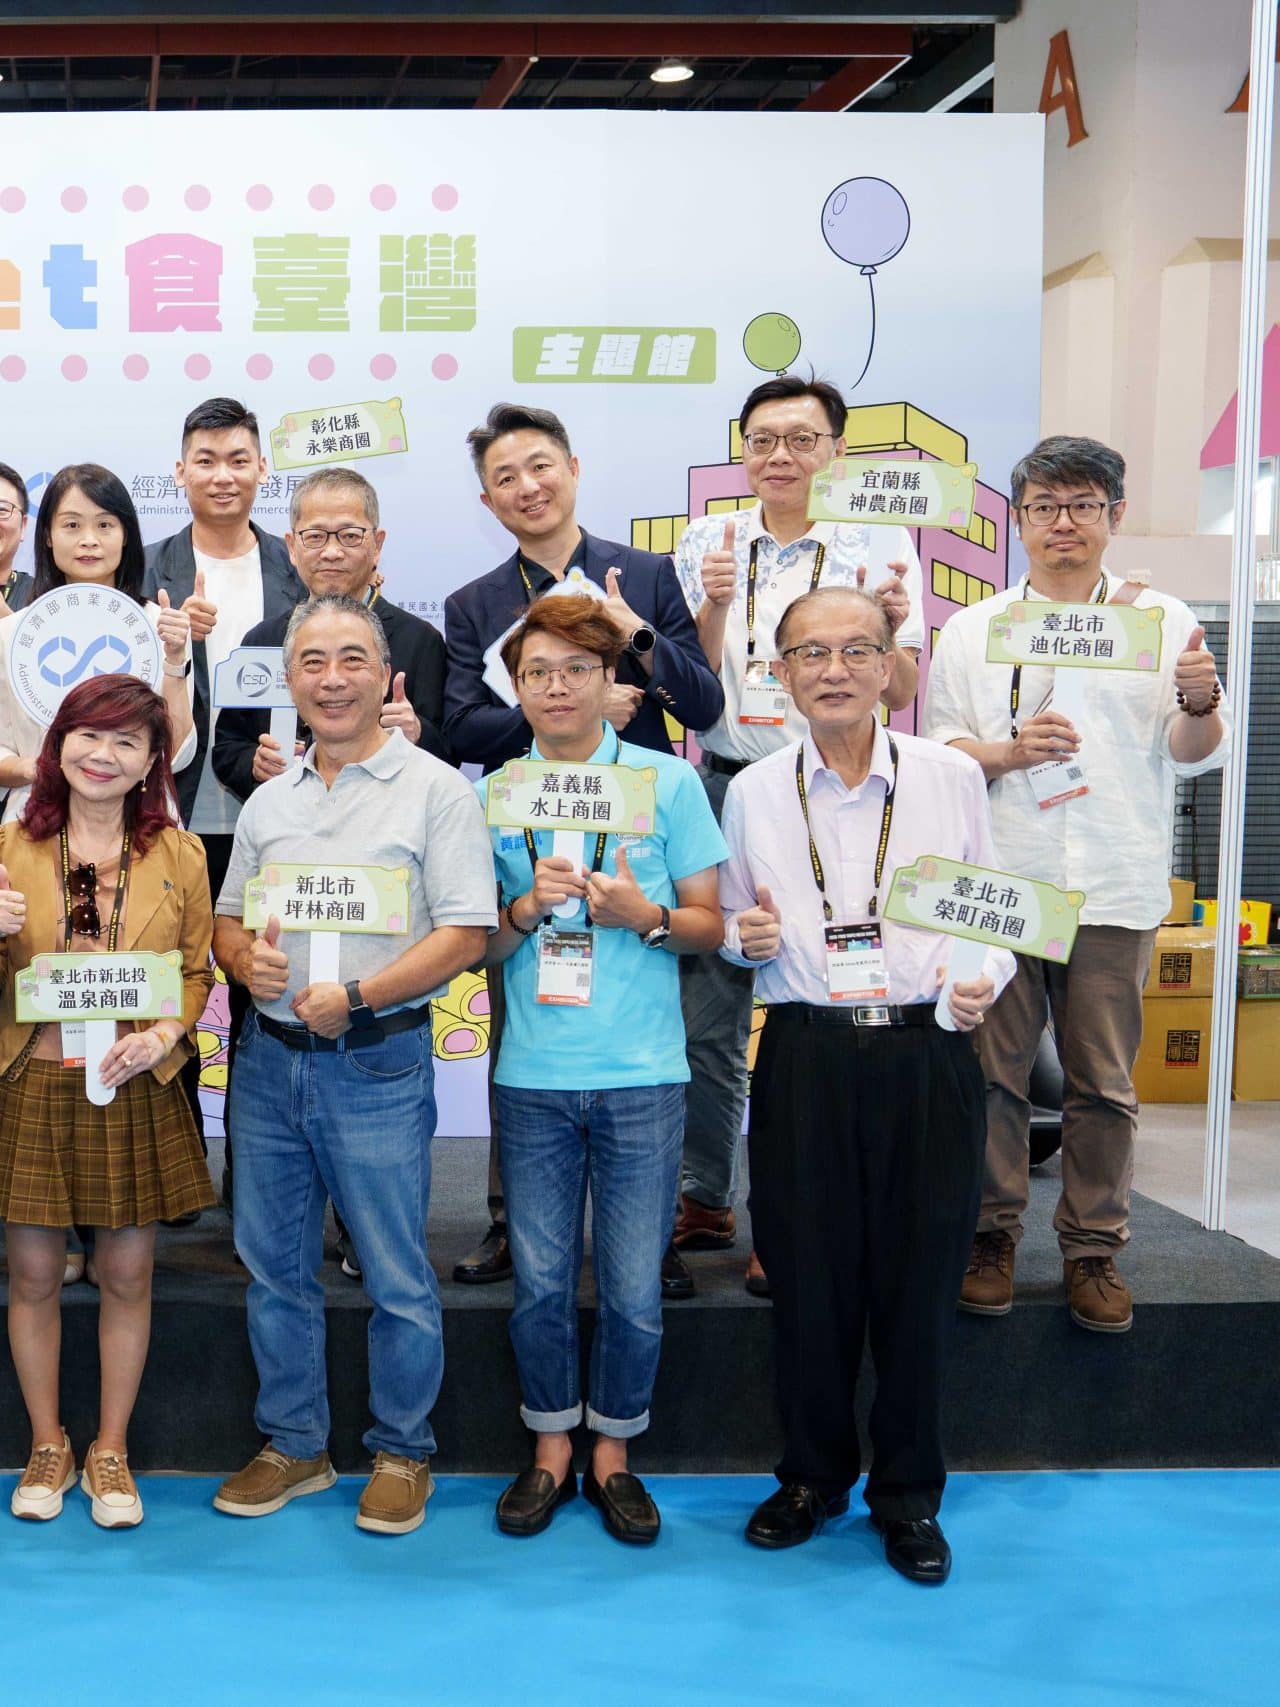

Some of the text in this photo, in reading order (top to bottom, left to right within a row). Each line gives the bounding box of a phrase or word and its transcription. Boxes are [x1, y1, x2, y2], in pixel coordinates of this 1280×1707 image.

[1038, 30, 1089, 147] A
[311, 413, 361, 435] 彰化縣
[306, 432, 371, 456] 永樂商圈
[861, 470, 921, 492] 宜蘭縣
[848, 493, 929, 516] 神農商圈
[1042, 613, 1105, 633] 臺北市
[1030, 635, 1114, 658] 迪化商圈
[542, 773, 602, 796] 嘉義縣
[530, 798, 611, 822] 水上商圈
[296, 875, 356, 895] 新北市
[952, 875, 1020, 909] 臺北市
[285, 899, 365, 921] 坪林商圈
[934, 898, 1026, 940] 榮町商圈
[49, 968, 147, 985] 臺北市新北投
[58, 989, 139, 1010] 溫泉商圈
